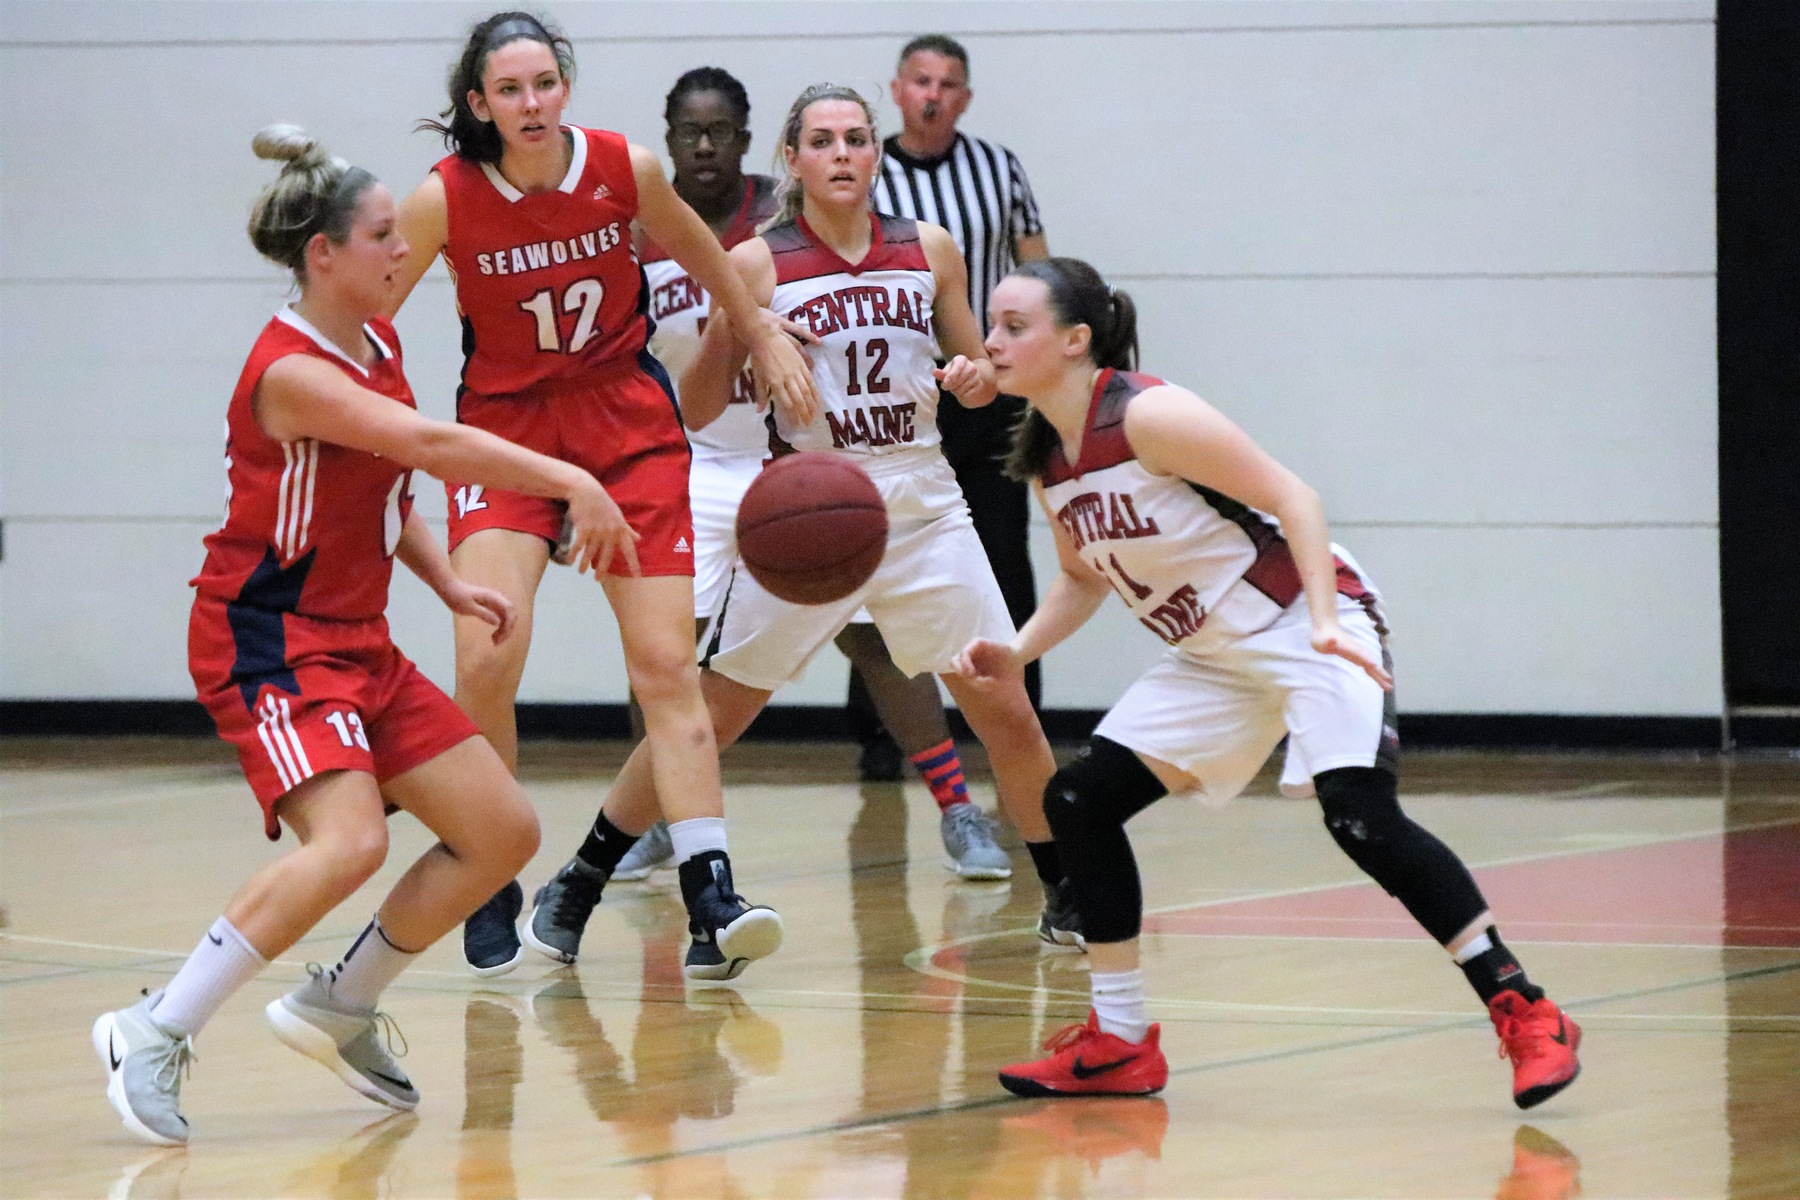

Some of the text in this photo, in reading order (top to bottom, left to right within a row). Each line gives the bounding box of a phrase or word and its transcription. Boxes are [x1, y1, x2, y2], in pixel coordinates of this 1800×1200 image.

[476, 221, 621, 276] SEAWOLVES
[517, 276, 607, 354] 12
[845, 338, 891, 396] 12
[825, 402, 917, 449] MAINE
[324, 710, 371, 752] 13
